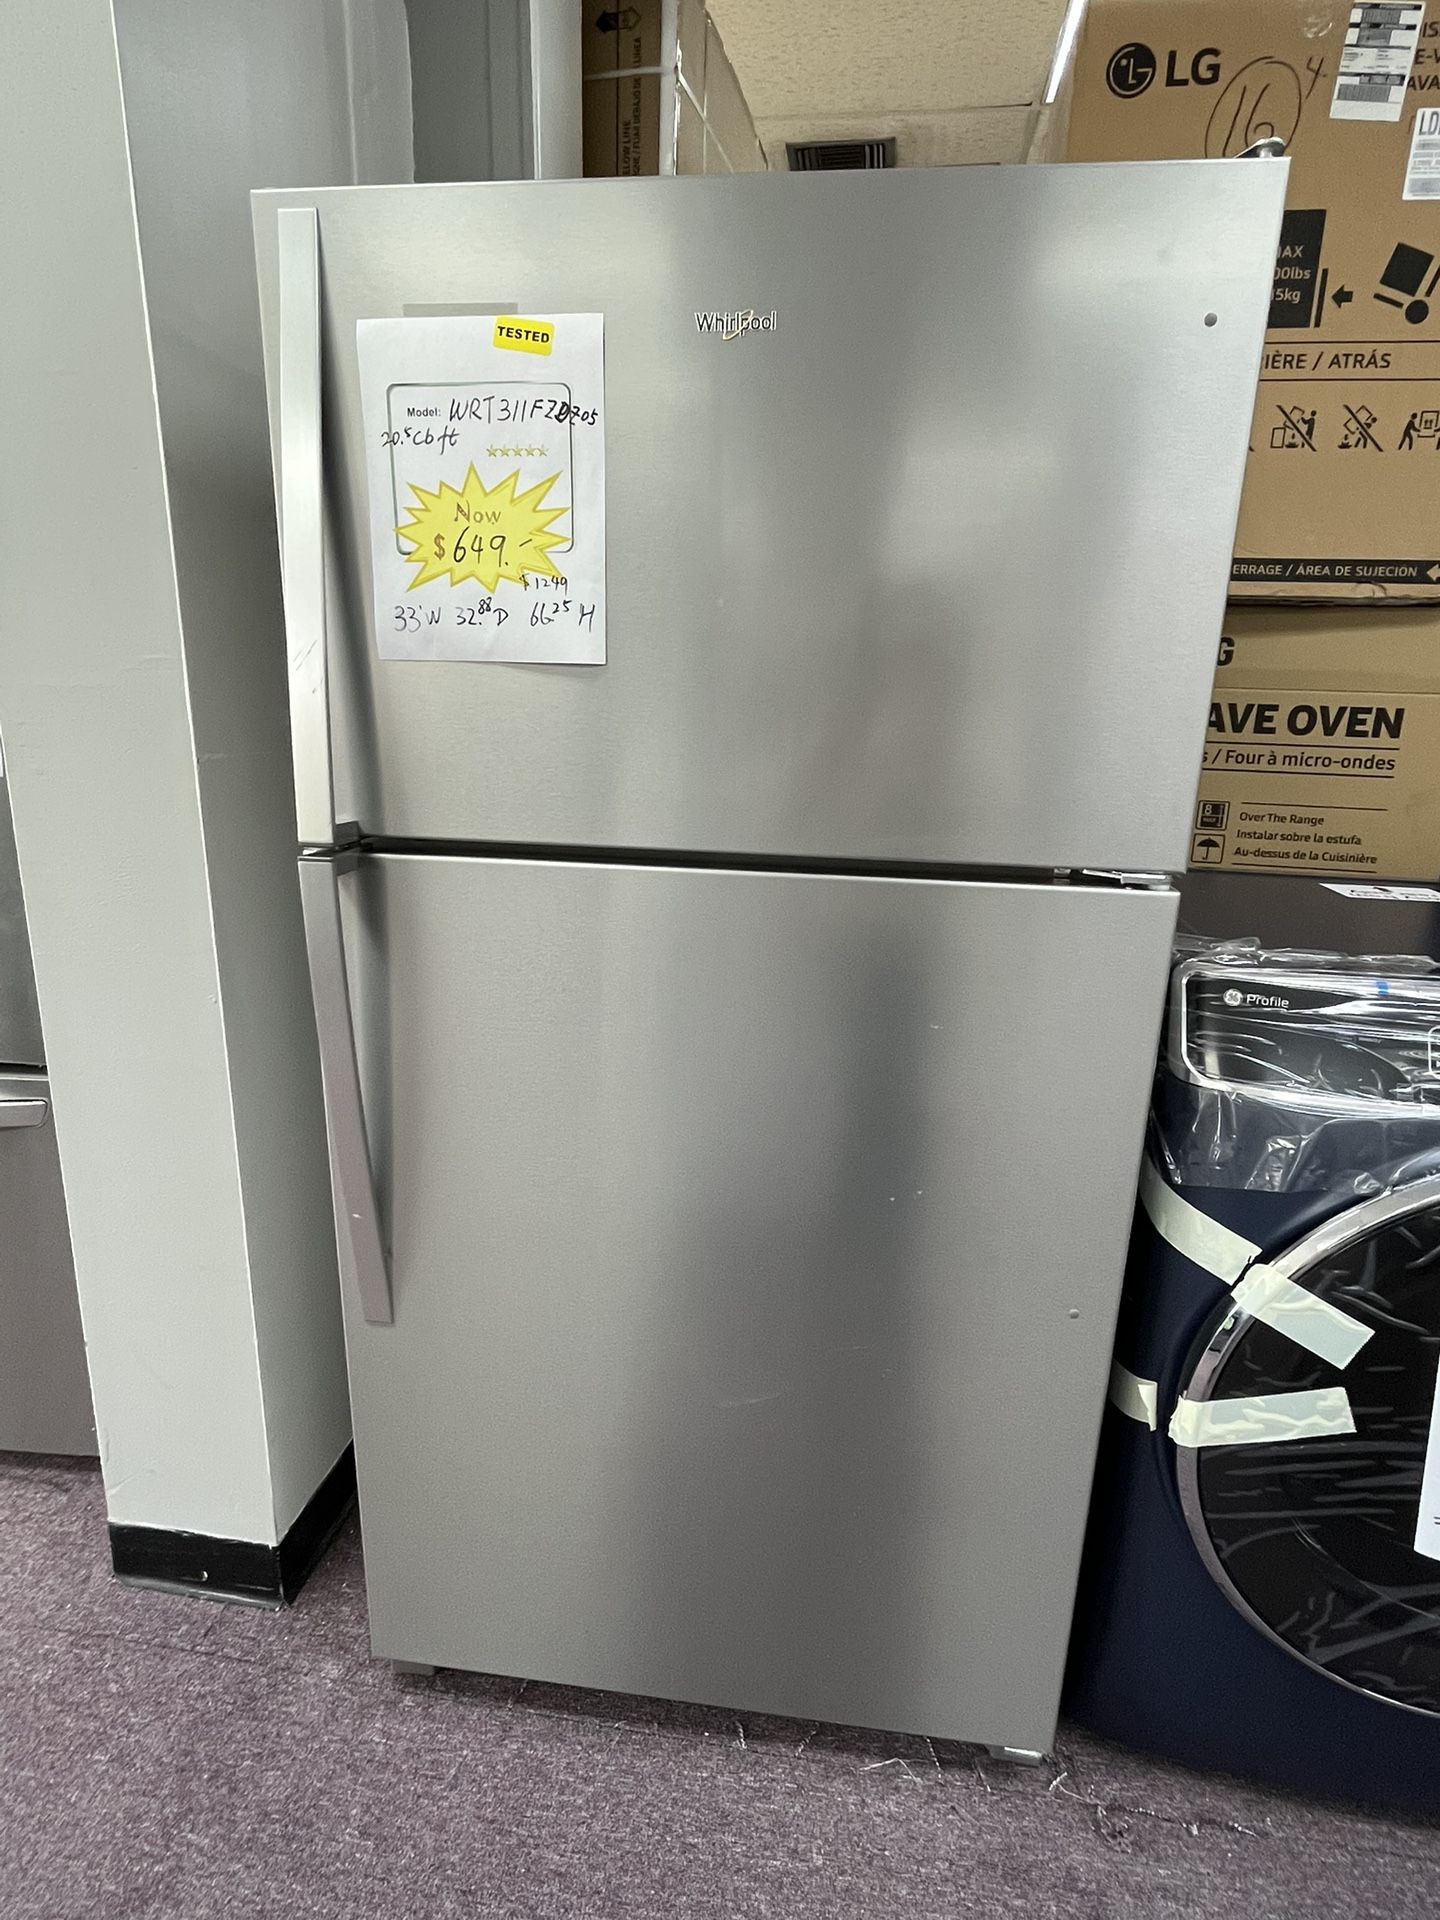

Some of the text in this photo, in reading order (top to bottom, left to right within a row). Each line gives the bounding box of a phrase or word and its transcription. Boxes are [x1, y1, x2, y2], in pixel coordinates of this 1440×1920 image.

[1165, 47, 1221, 87] LG
[1418, 110, 1440, 136] LD
[622, 145, 631, 176] ELOW
[1277, 245, 1304, 258] AX
[694, 310, 777, 338] Whirlpool
[497, 325, 551, 345] TESTED
[1260, 350, 1307, 370] IÈRE
[1328, 348, 1392, 369] ATRÁS
[406, 406, 442, 419] Model:
[1334, 565, 1352, 577] DE
[1286, 704, 1405, 739] OVEN
[1225, 749, 1265, 766] Four
[1267, 750, 1277, 766] à
[1281, 751, 1396, 771] micro-ondes
[1239, 811, 1325, 827] Over The Range
[1236, 828, 1362, 846] Instalar sobre la estufa
[1233, 846, 1378, 865] Au-dessus de la Cuisinière
[1246, 990, 1290, 1009] Profile
